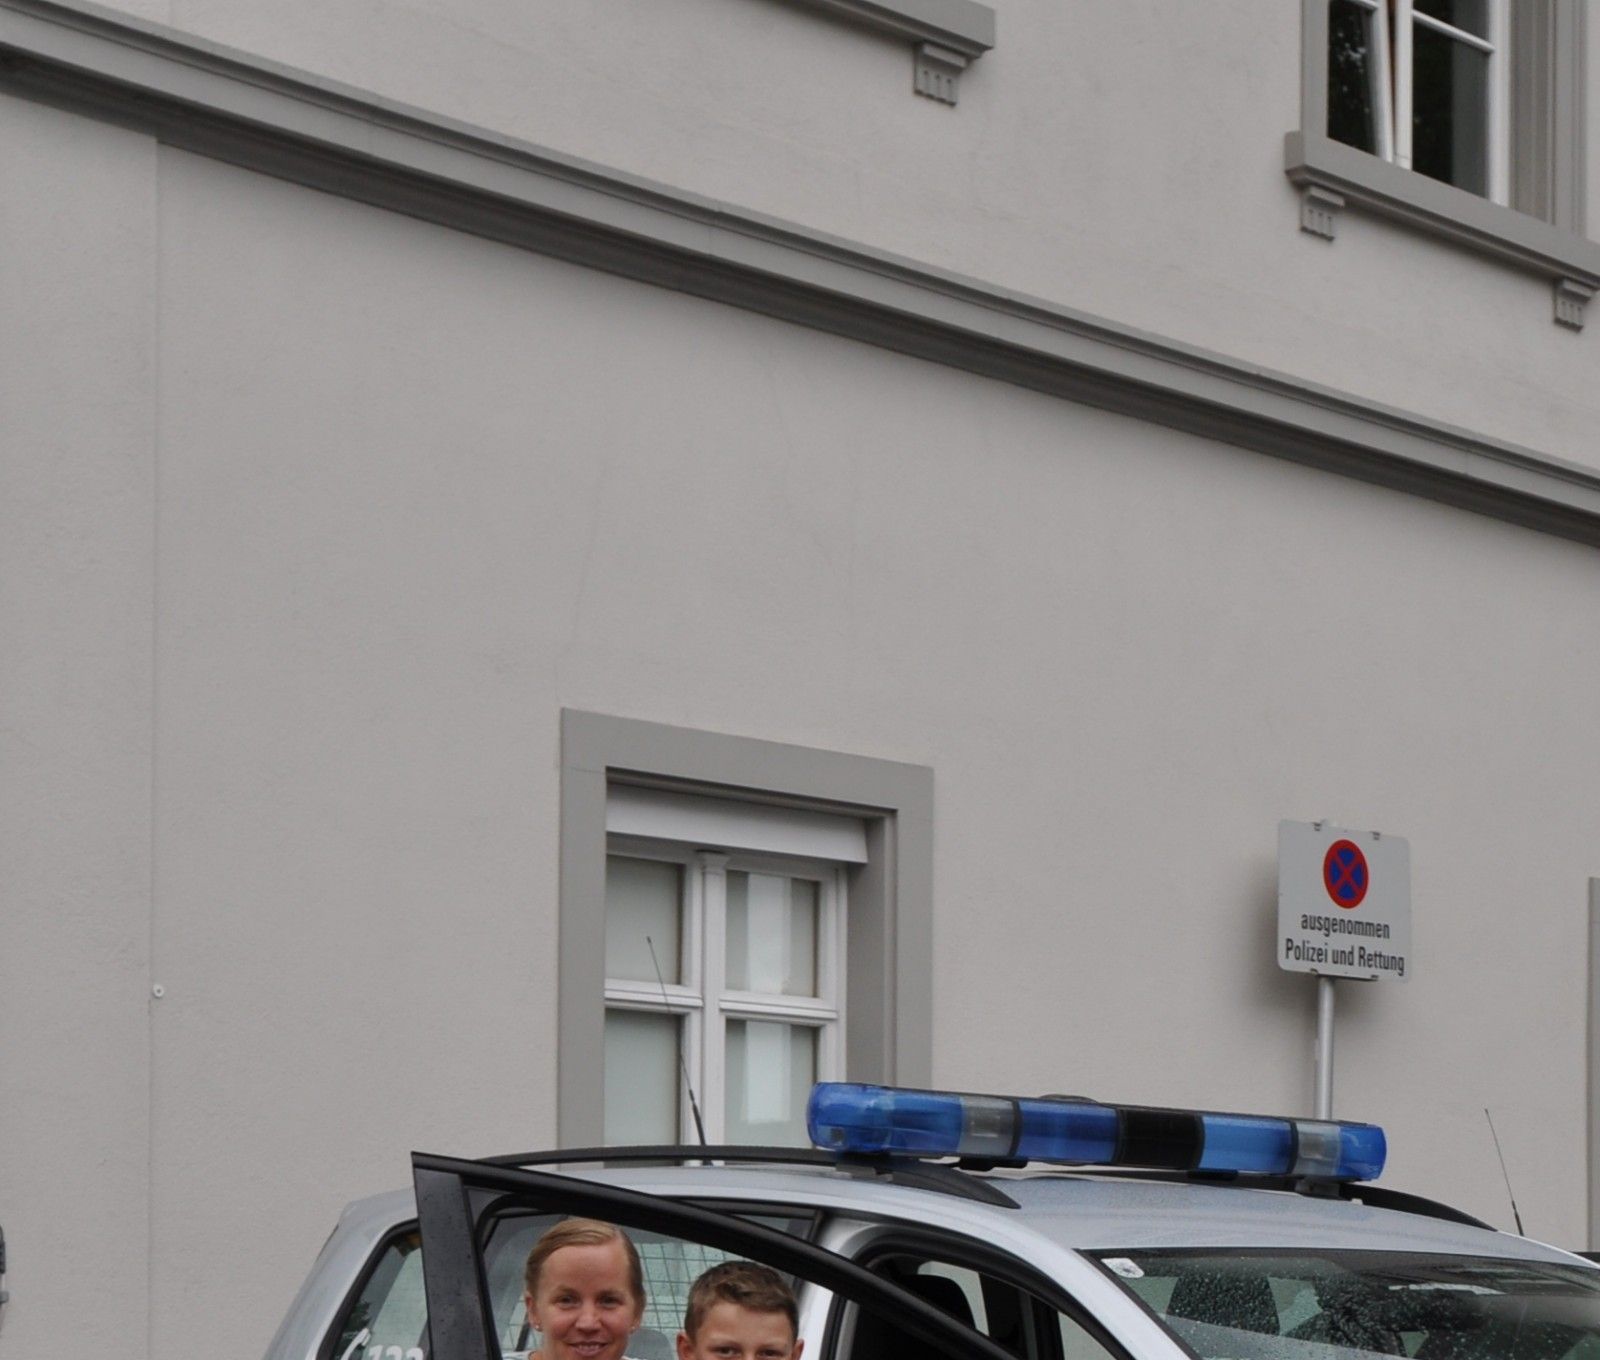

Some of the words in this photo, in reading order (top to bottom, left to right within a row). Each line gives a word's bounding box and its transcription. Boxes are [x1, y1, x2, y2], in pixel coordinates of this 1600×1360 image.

[1301, 913, 1390, 939] ausgenommen
[1285, 938, 1328, 963] Polizei
[1332, 945, 1354, 966] und
[1358, 946, 1405, 977] Rettung
